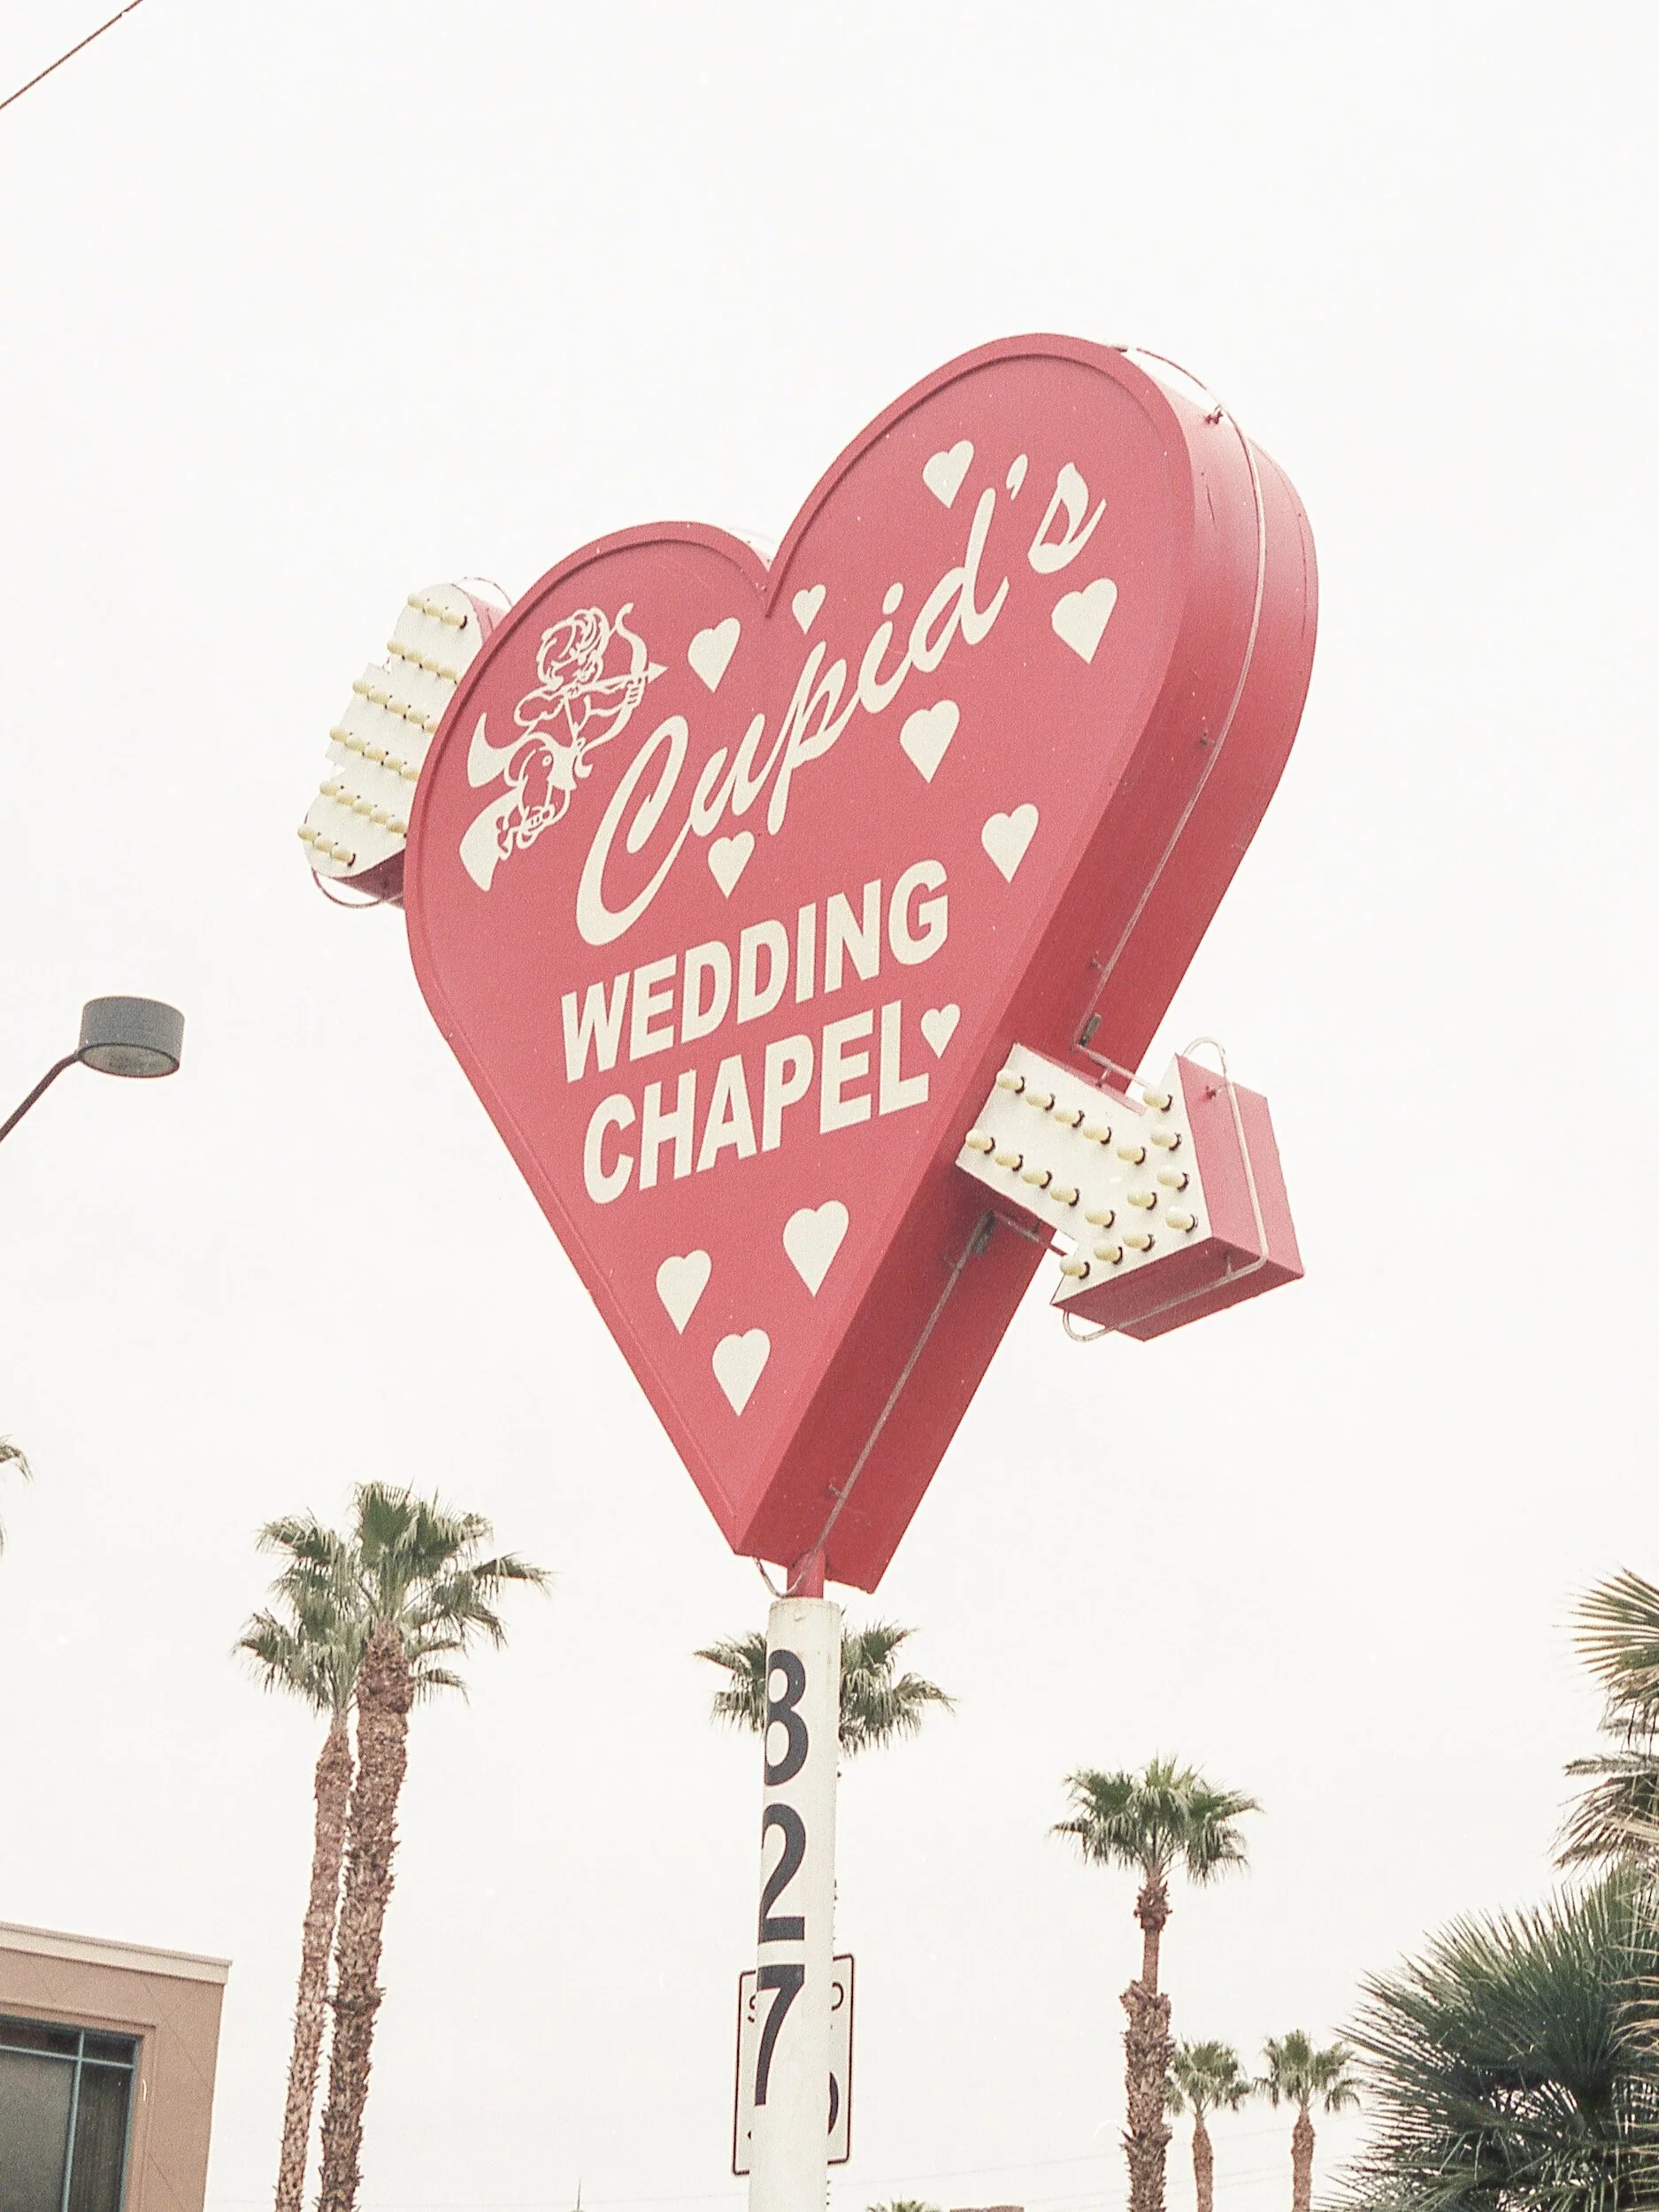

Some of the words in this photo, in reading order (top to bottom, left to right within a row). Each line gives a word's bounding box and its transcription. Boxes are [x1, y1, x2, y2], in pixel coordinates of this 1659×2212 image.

[575, 454, 1108, 946] Cupid's
[561, 859, 949, 1083] WEDDING
[583, 1001, 930, 1204] CHAPEL
